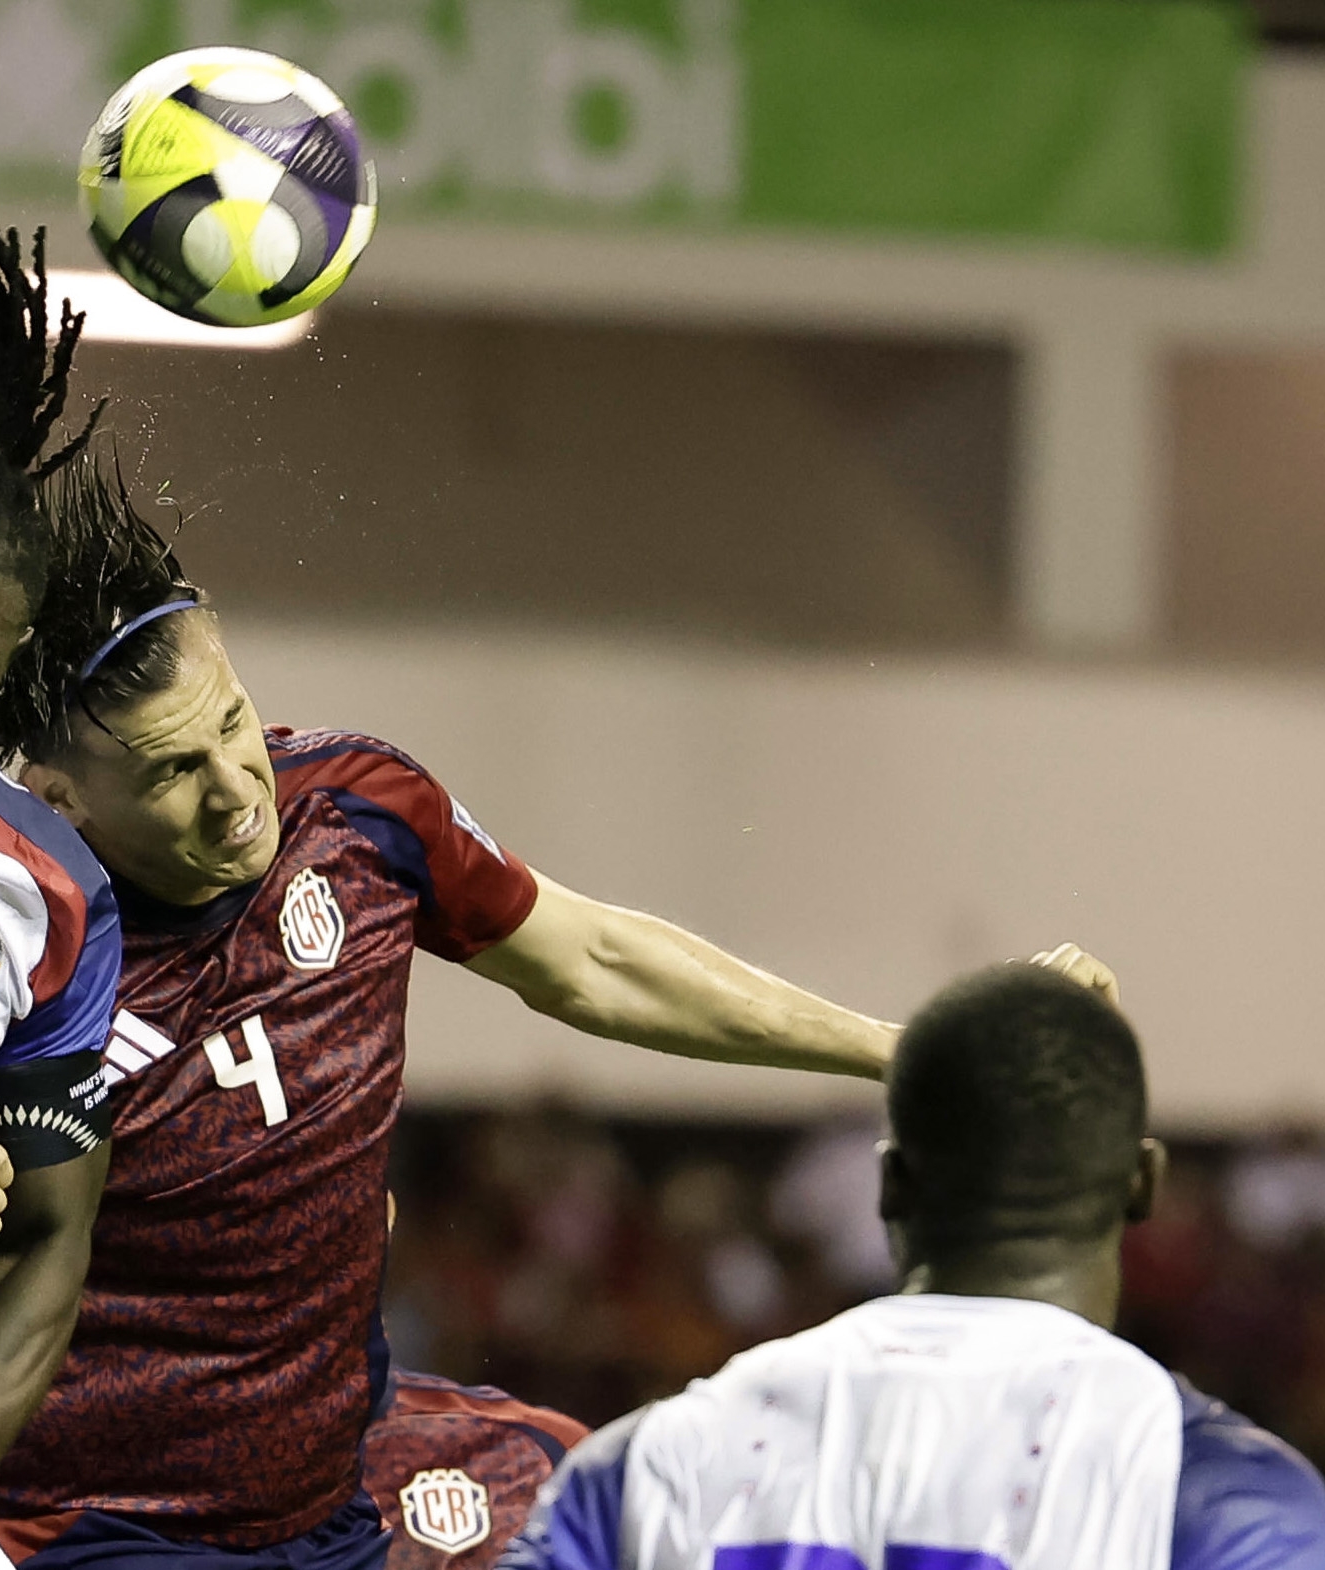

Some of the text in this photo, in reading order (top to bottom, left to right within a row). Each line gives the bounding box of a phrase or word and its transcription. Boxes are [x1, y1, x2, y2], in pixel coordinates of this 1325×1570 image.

[202, 1014, 288, 1127] 4
[84, 1095, 94, 1110] IS
[422, 1487, 468, 1534] CR
